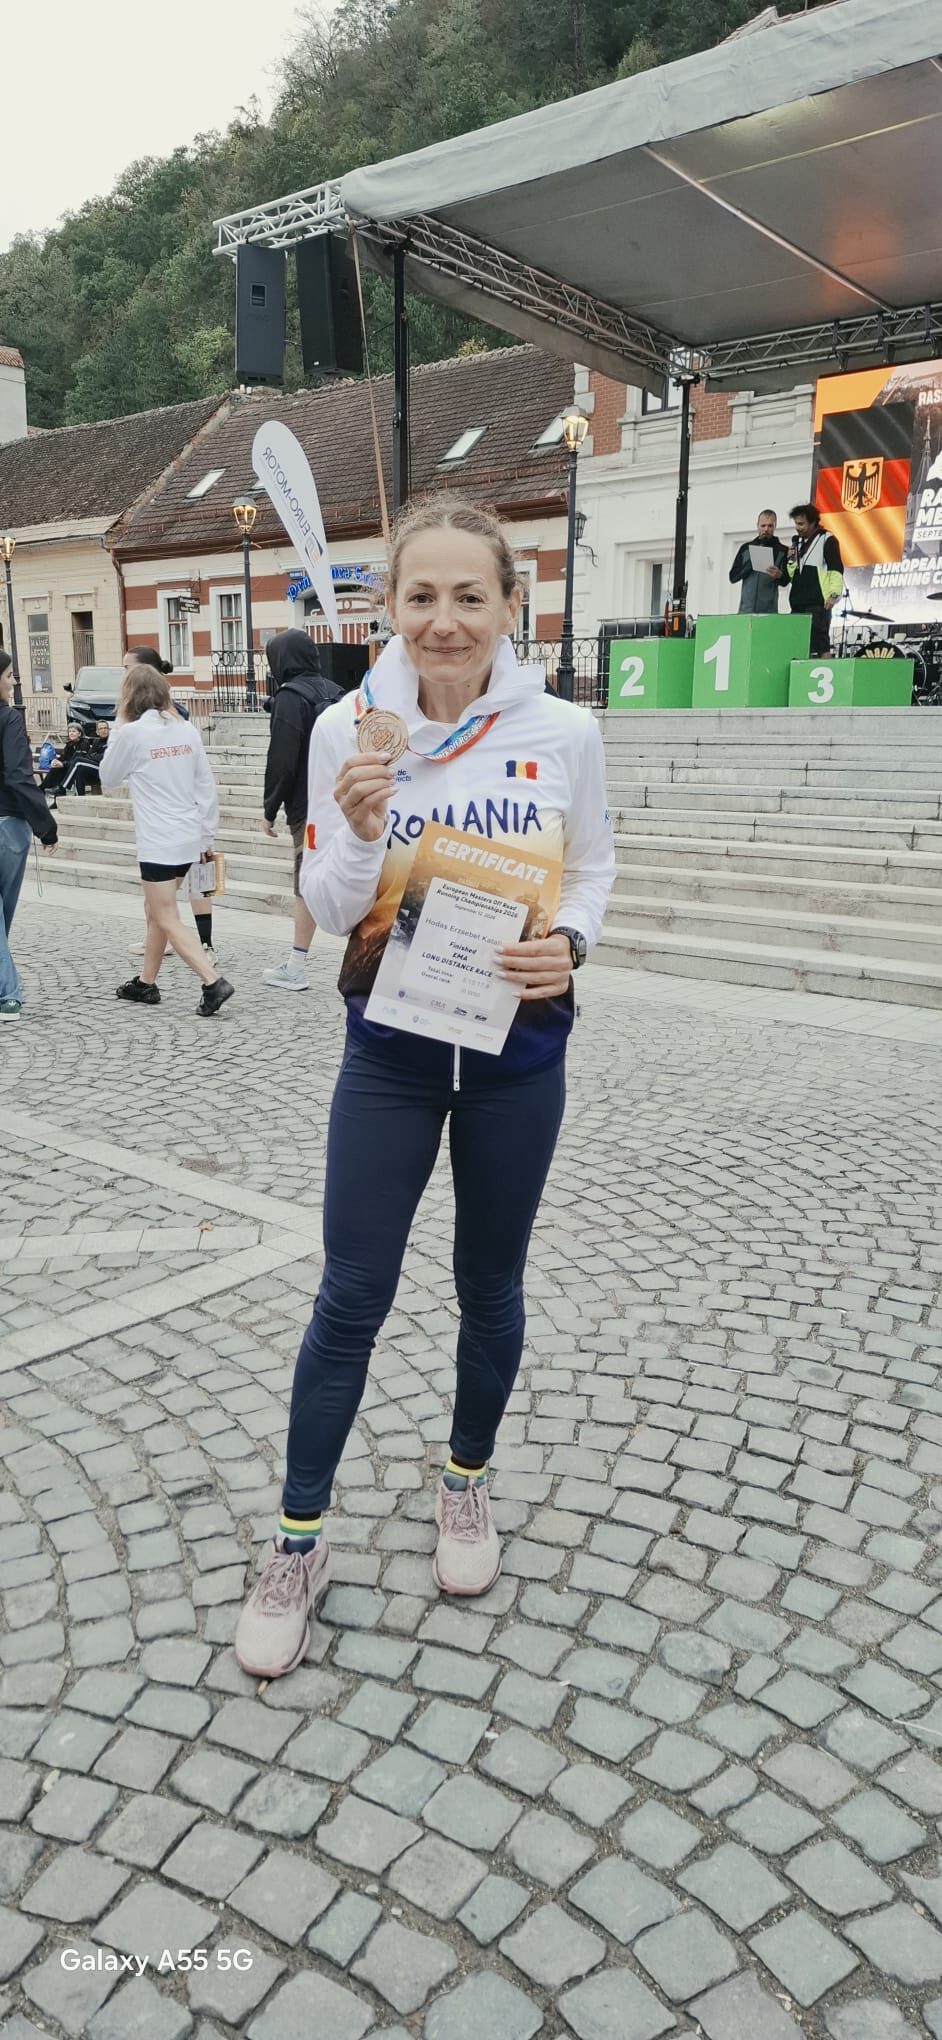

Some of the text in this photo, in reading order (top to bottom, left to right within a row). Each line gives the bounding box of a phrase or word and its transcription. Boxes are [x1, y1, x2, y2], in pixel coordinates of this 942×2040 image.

[870, 571, 930, 588] RUNNING
[619, 656, 645, 697] 2
[703, 635, 731, 691] 1
[807, 667, 834, 704] 3
[386, 798, 542, 849] ROMANIA
[433, 836, 549, 885] CERTIFICATE
[436, 889, 460, 902] Running
[460, 896, 502, 914] Championships
[442, 883, 468, 896] European
[470, 892, 492, 904] Masters
[502, 902, 518, 911] Road
[454, 904, 477, 914] September
[449, 941, 477, 954] Finished
[452, 952, 468, 961] EMA
[422, 951, 493, 978] LONG DISTANCE RACE
